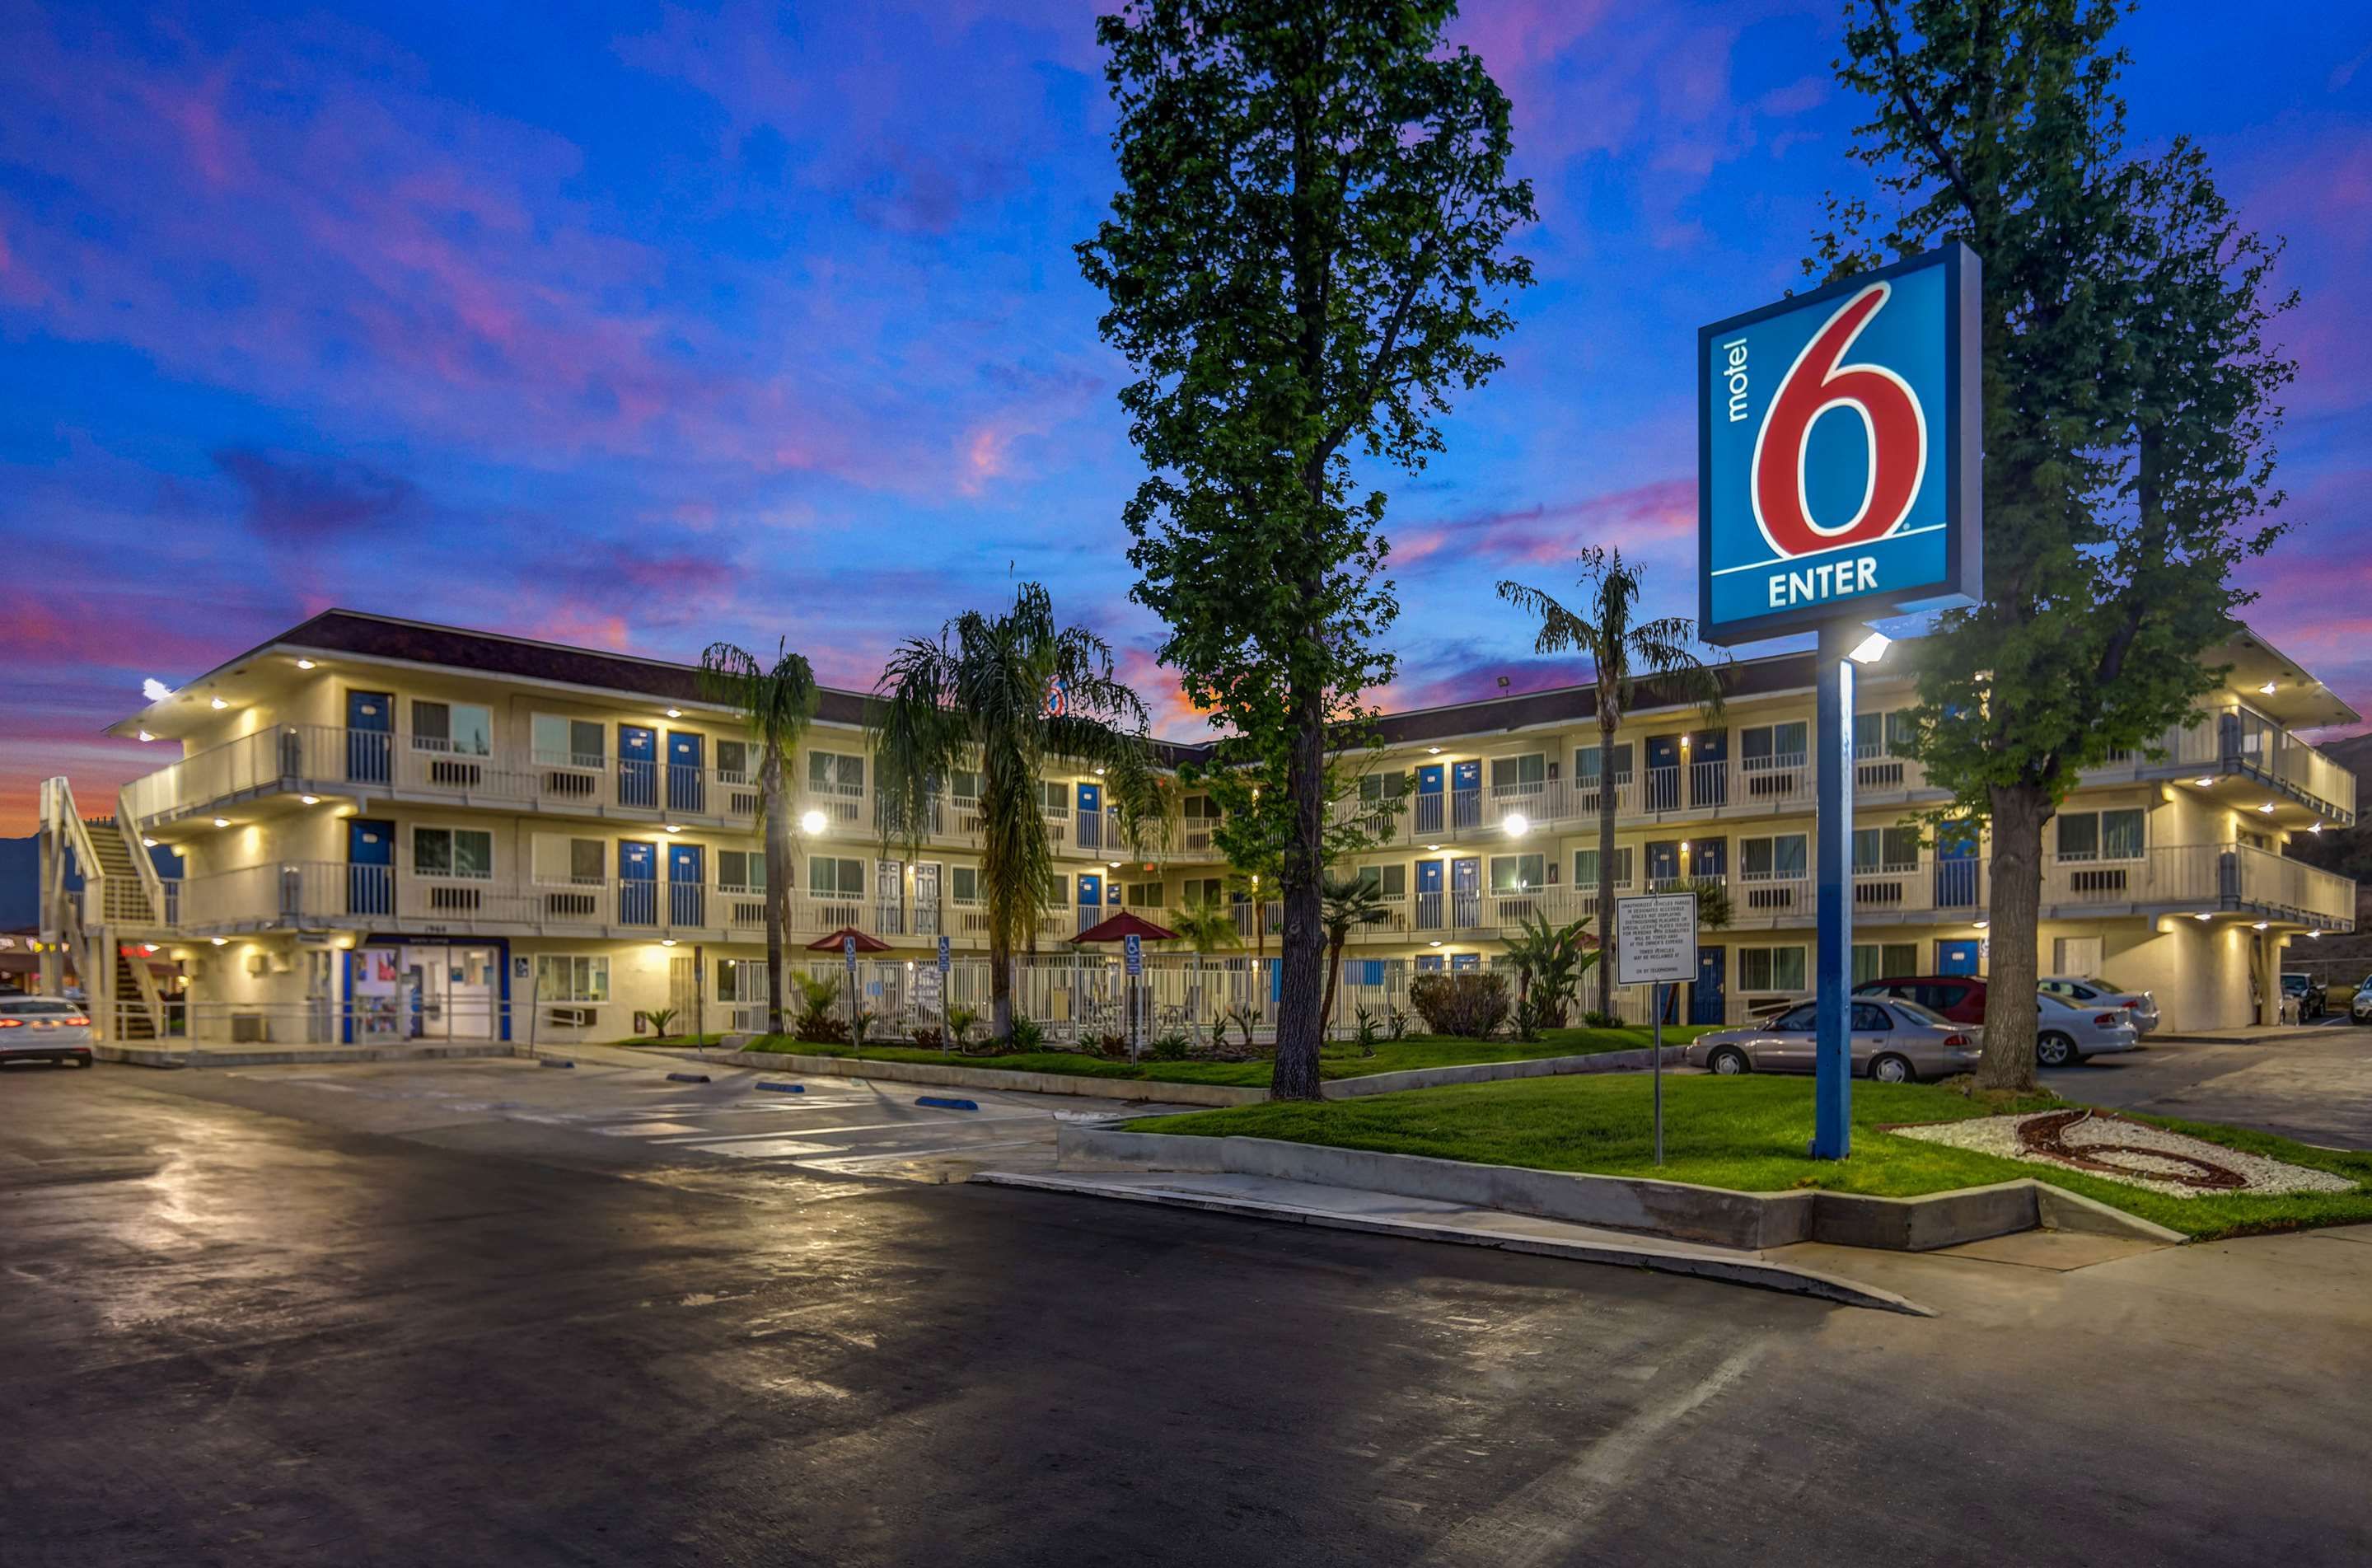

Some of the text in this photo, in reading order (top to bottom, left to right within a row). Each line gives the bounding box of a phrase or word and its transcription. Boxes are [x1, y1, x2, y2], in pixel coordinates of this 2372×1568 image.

[1724, 280, 1928, 559] motel 6
[1769, 556, 1878, 607] ENTER
[1042, 674, 1066, 717] 6
